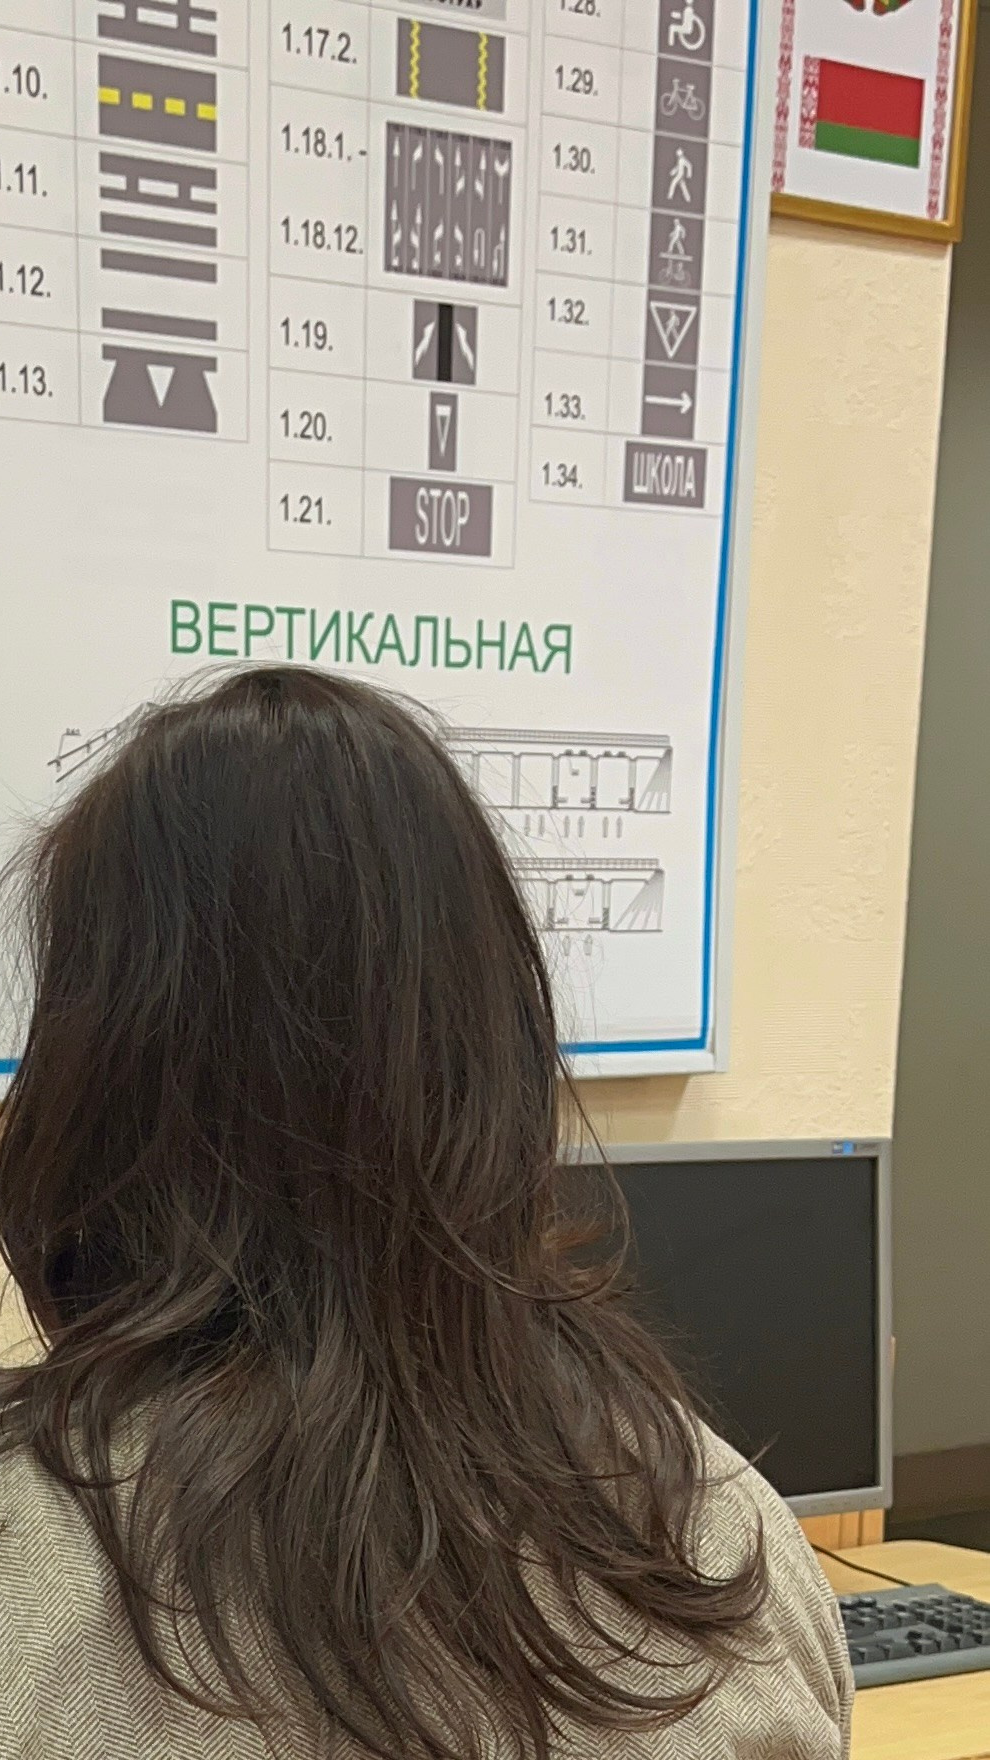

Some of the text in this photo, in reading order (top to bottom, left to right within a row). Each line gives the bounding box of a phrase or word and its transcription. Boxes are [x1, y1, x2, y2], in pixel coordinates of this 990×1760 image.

[283, 23, 356, 63] 1.17.2.
[556, 65, 597, 95] 1.29.
[554, 143, 595, 173] 1.30.
[282, 216, 363, 254] 1.18.12.
[551, 227, 591, 255] 1.31.
[549, 298, 589, 325] 1.32.
[281, 317, 333, 351] 1.19.
[545, 392, 585, 419] 1.33.
[281, 409, 332, 441] 1.20.
[543, 462, 582, 488] 1.34.
[633, 456, 695, 499] ШКОЛА
[280, 494, 331, 525] 1.21.
[415, 486, 470, 546] STOP
[170, 599, 572, 673] ВЕРТИКАЛЬНАЯ
